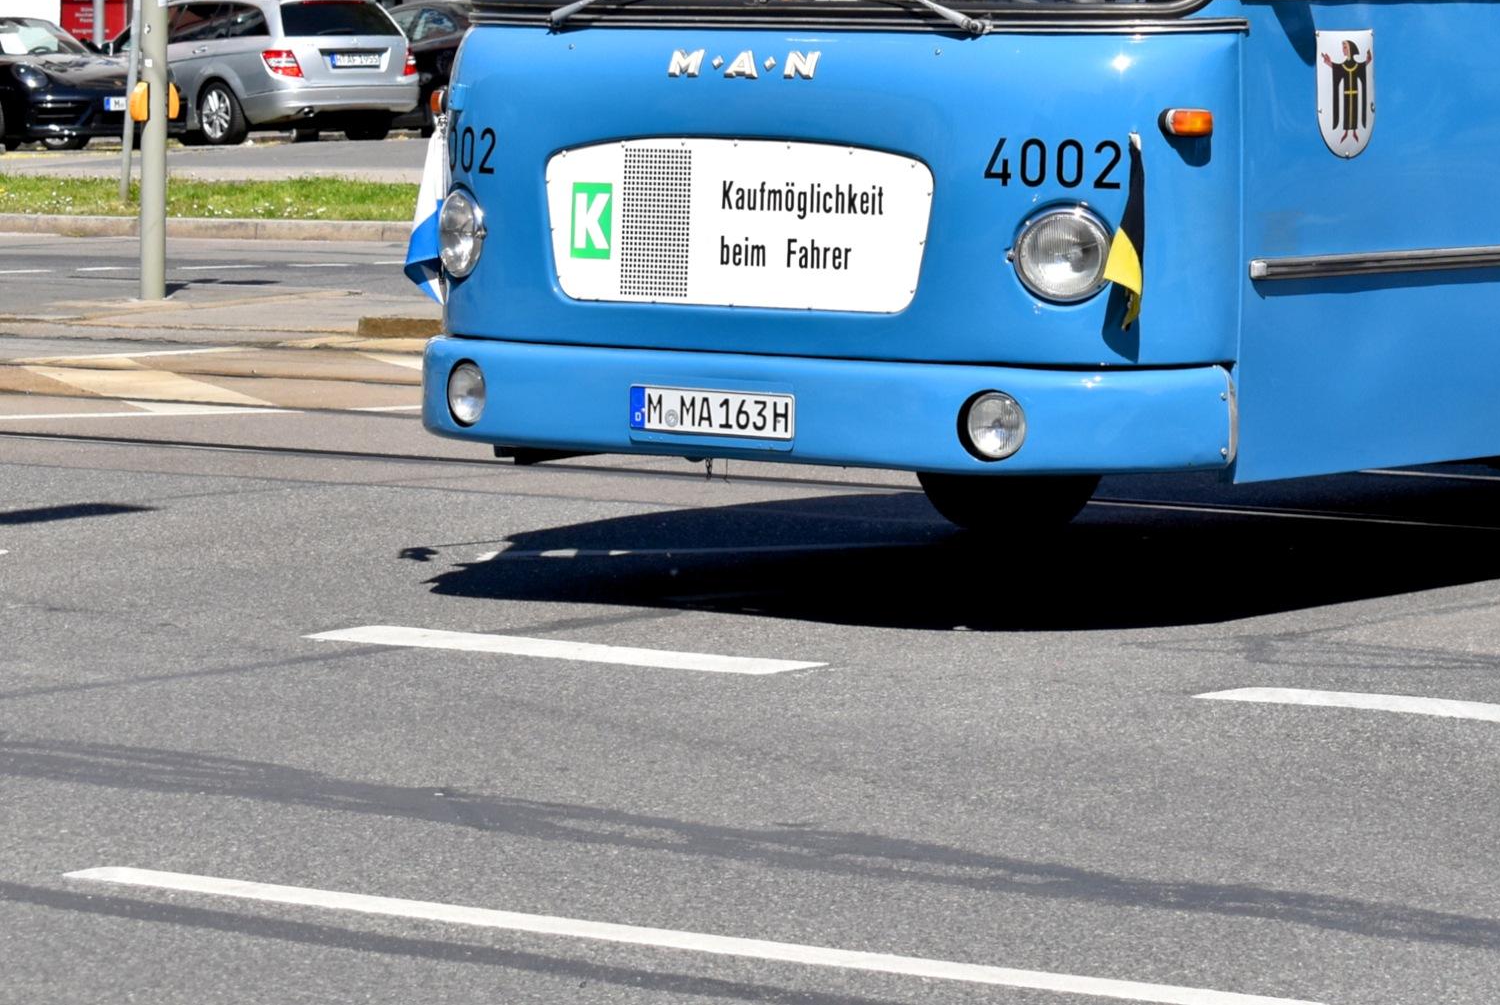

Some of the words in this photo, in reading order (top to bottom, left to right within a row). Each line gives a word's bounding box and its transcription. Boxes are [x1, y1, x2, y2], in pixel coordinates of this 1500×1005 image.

[449, 126, 496, 175] 002
[984, 137, 1122, 190] 4002
[573, 192, 611, 250] K
[721, 180, 884, 220] Kaufmöglichkeit
[719, 235, 767, 268] beim
[786, 238, 853, 271] Fahrer
